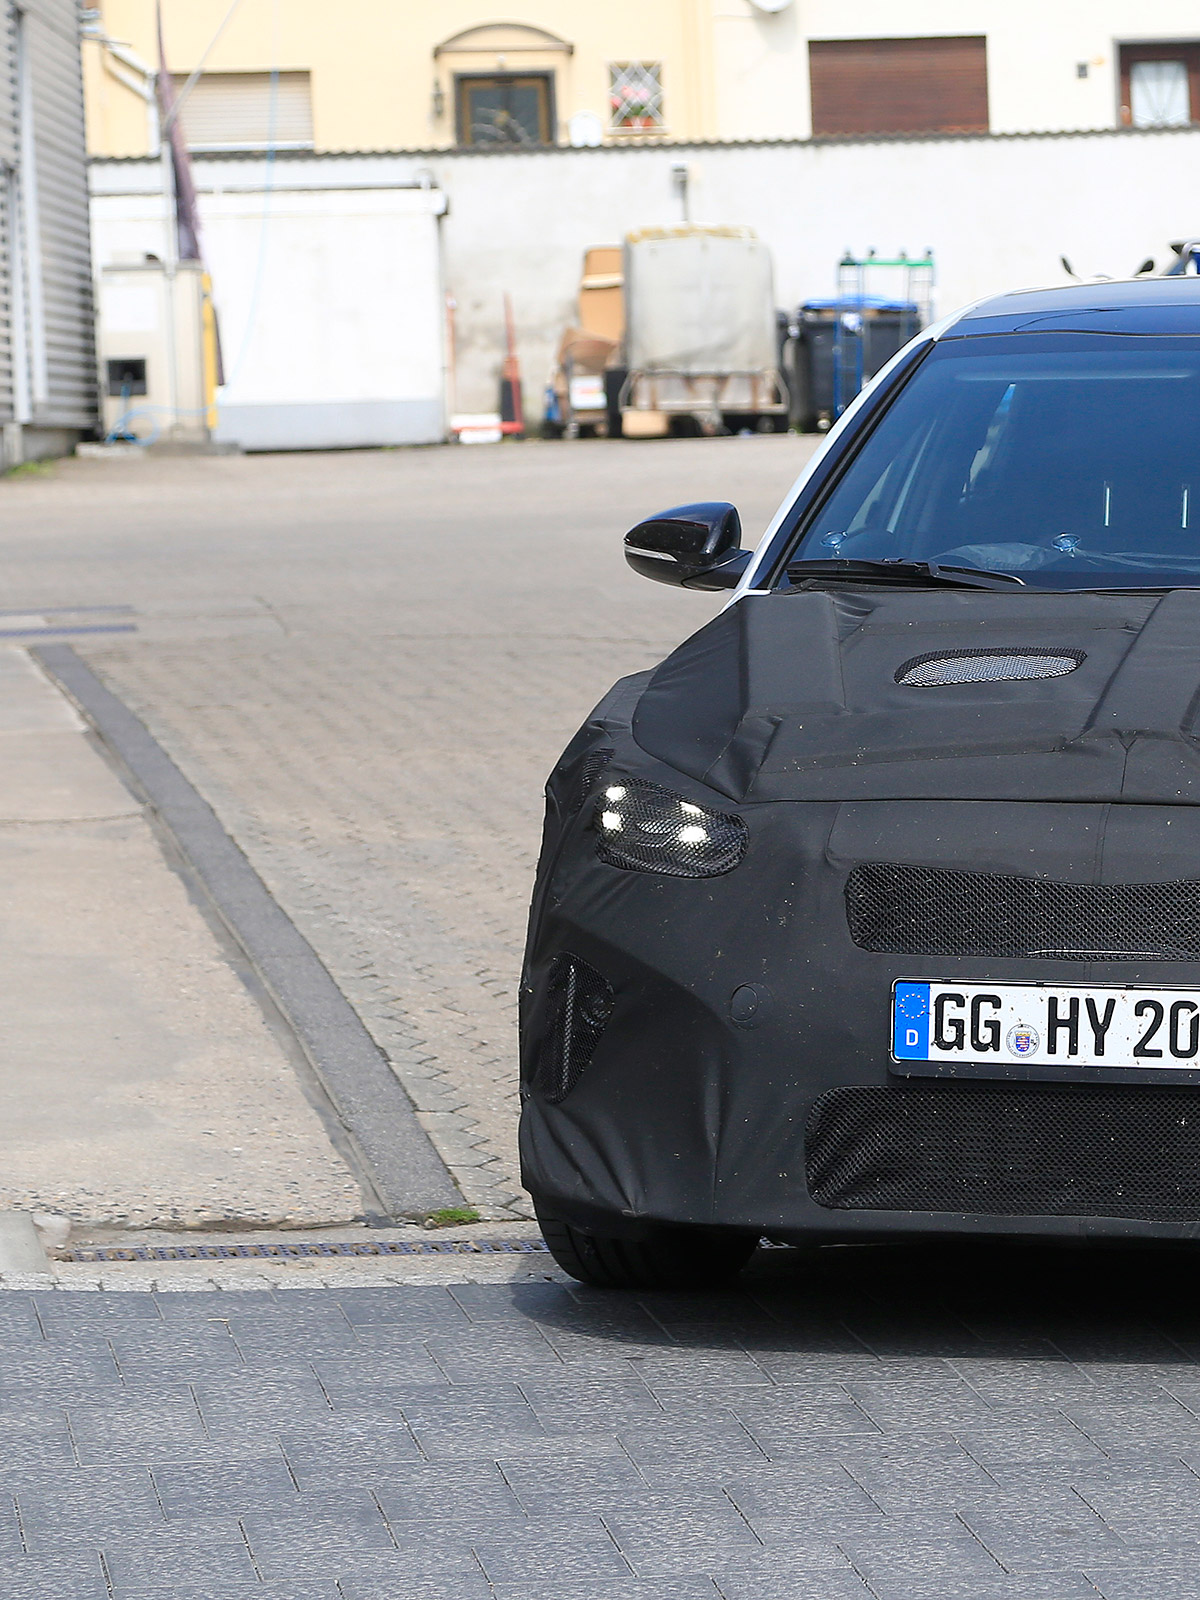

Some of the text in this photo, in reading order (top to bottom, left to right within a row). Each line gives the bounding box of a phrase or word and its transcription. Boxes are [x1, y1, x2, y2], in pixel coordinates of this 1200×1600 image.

[905, 1029, 919, 1046] D
[934, 993, 1002, 1052] GG
[1047, 996, 1116, 1057] HY
